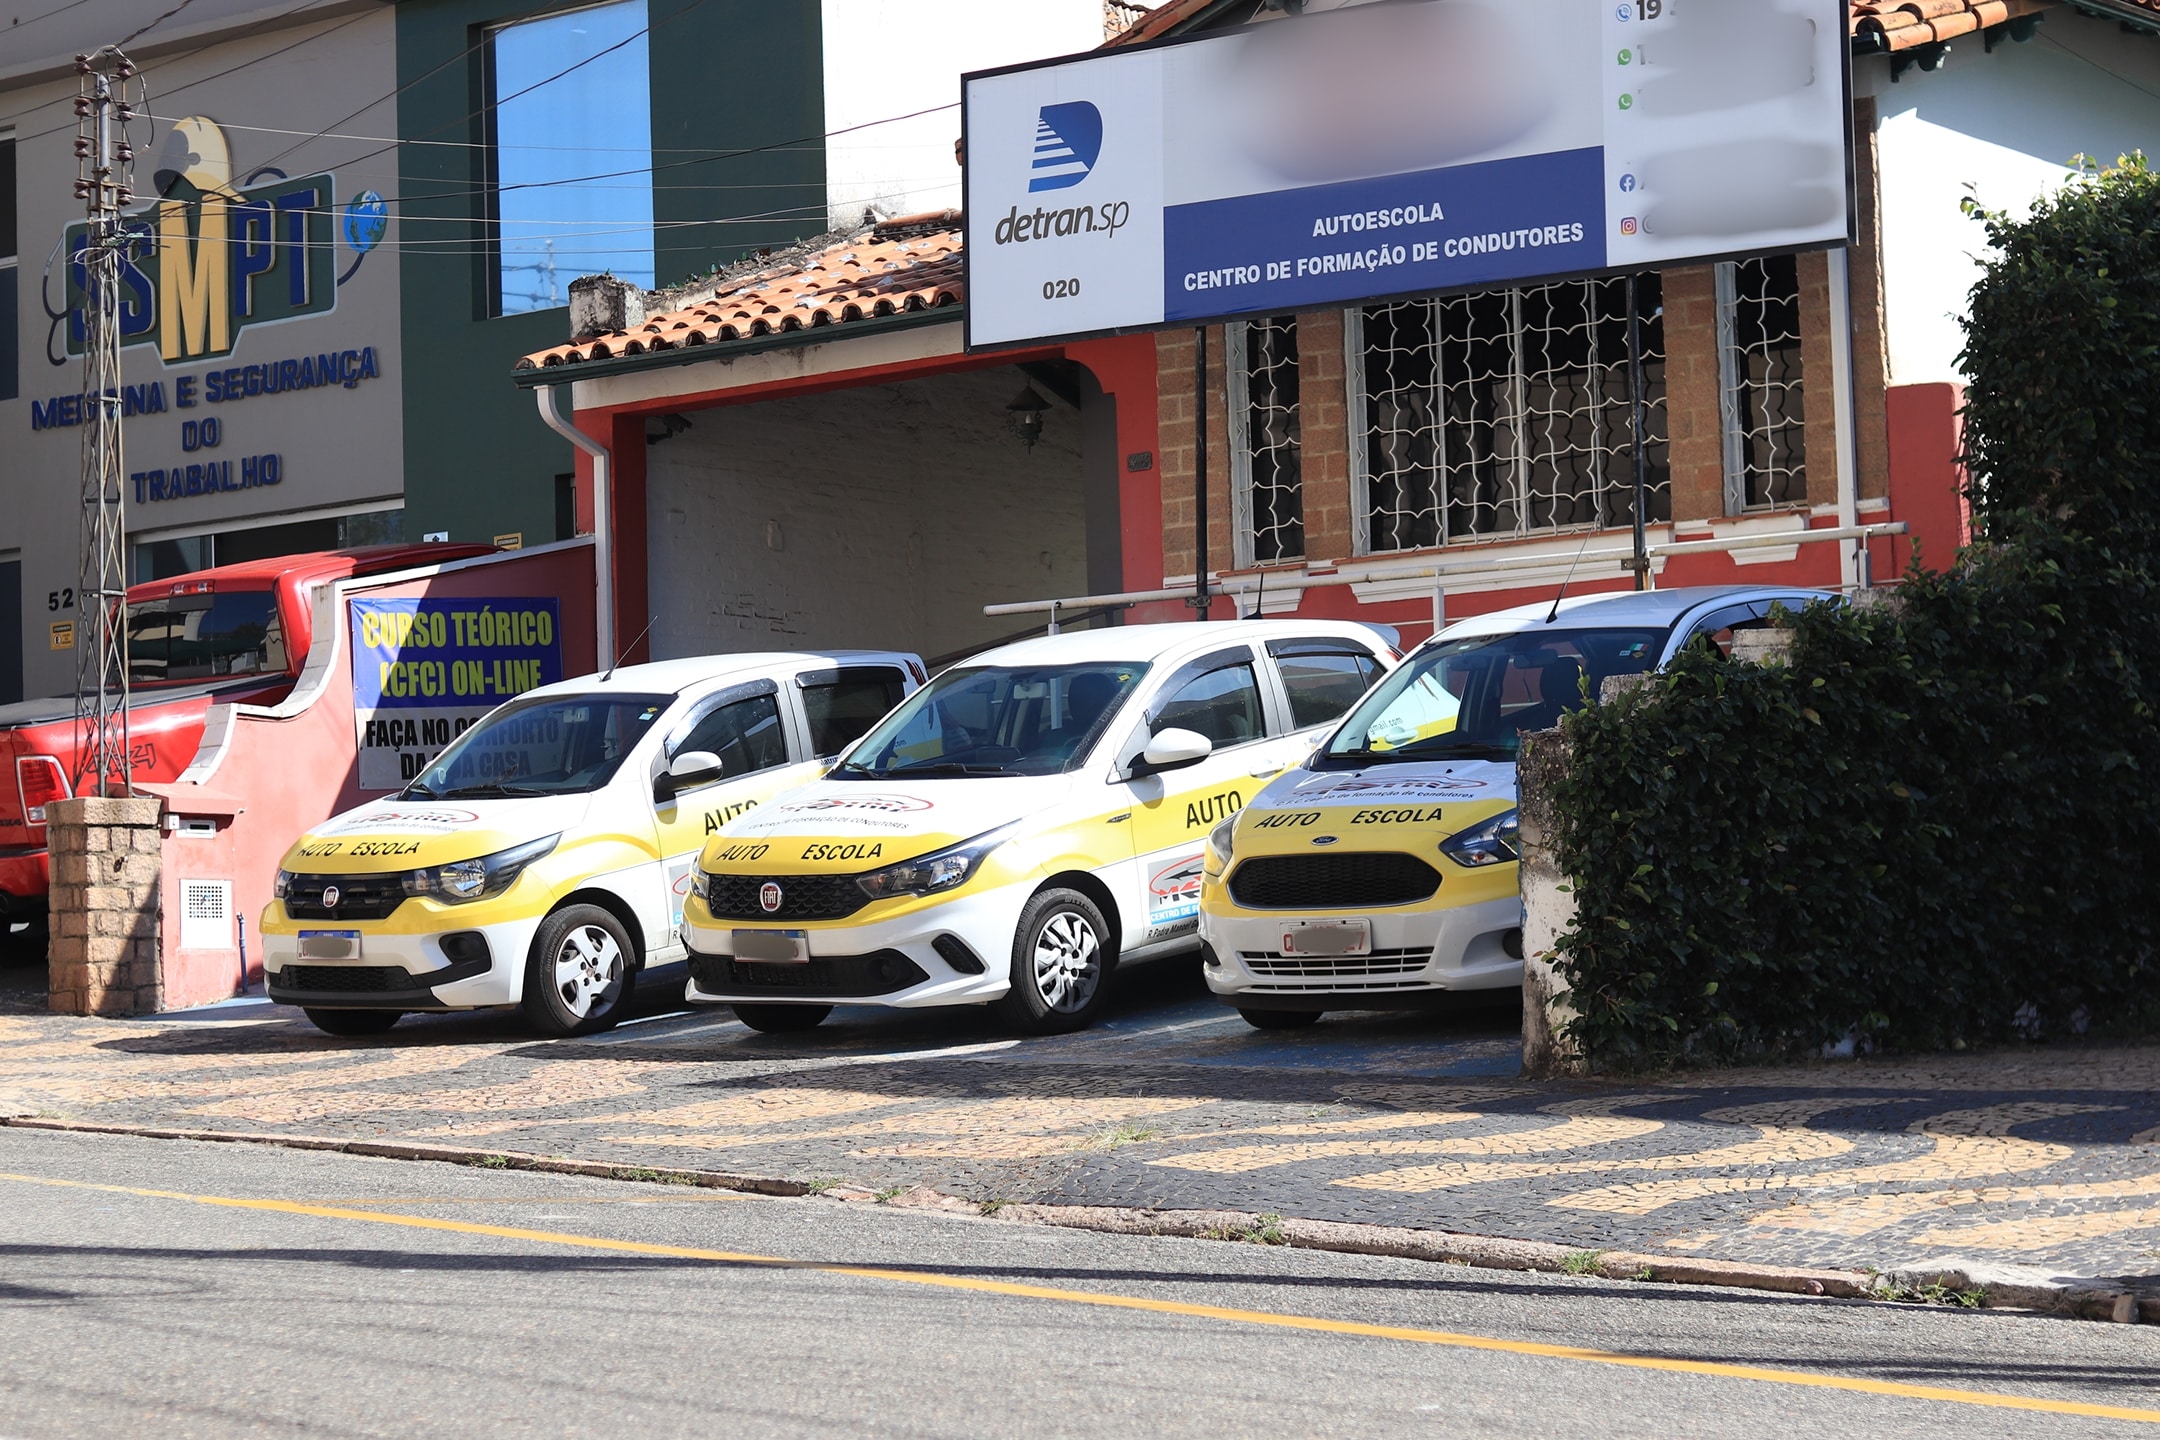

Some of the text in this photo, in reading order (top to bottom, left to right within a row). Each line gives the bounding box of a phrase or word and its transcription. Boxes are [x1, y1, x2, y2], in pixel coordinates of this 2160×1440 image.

[995, 201, 1129, 245] detran.sp
[1312, 202, 1444, 237] AUTOESCOLA
[1184, 222, 1584, 291] CENTRO DE FORMAÇÃO DE CONDUTORES
[1043, 278, 1080, 300] 020
[32, 346, 379, 431] MEDCINA E SEGURANÇA
[182, 416, 221, 451] DO
[131, 453, 282, 504] TRABALHO
[48, 588, 74, 611] 52
[362, 605, 552, 649] CURSO TEÓRICO
[452, 659, 541, 696] ON-LINE
[366, 719, 418, 752] FAÇA
[421, 718, 450, 746] NO
[401, 752, 427, 780] DA
[479, 751, 532, 778] CASA
[1187, 790, 1243, 829] AUTO
[1254, 807, 1443, 829] AUTO ESCOLA
[350, 842, 420, 856] ESCOLA
[716, 843, 883, 861] AUTO ESCOLA
[764, 890, 777, 904] FIAT
